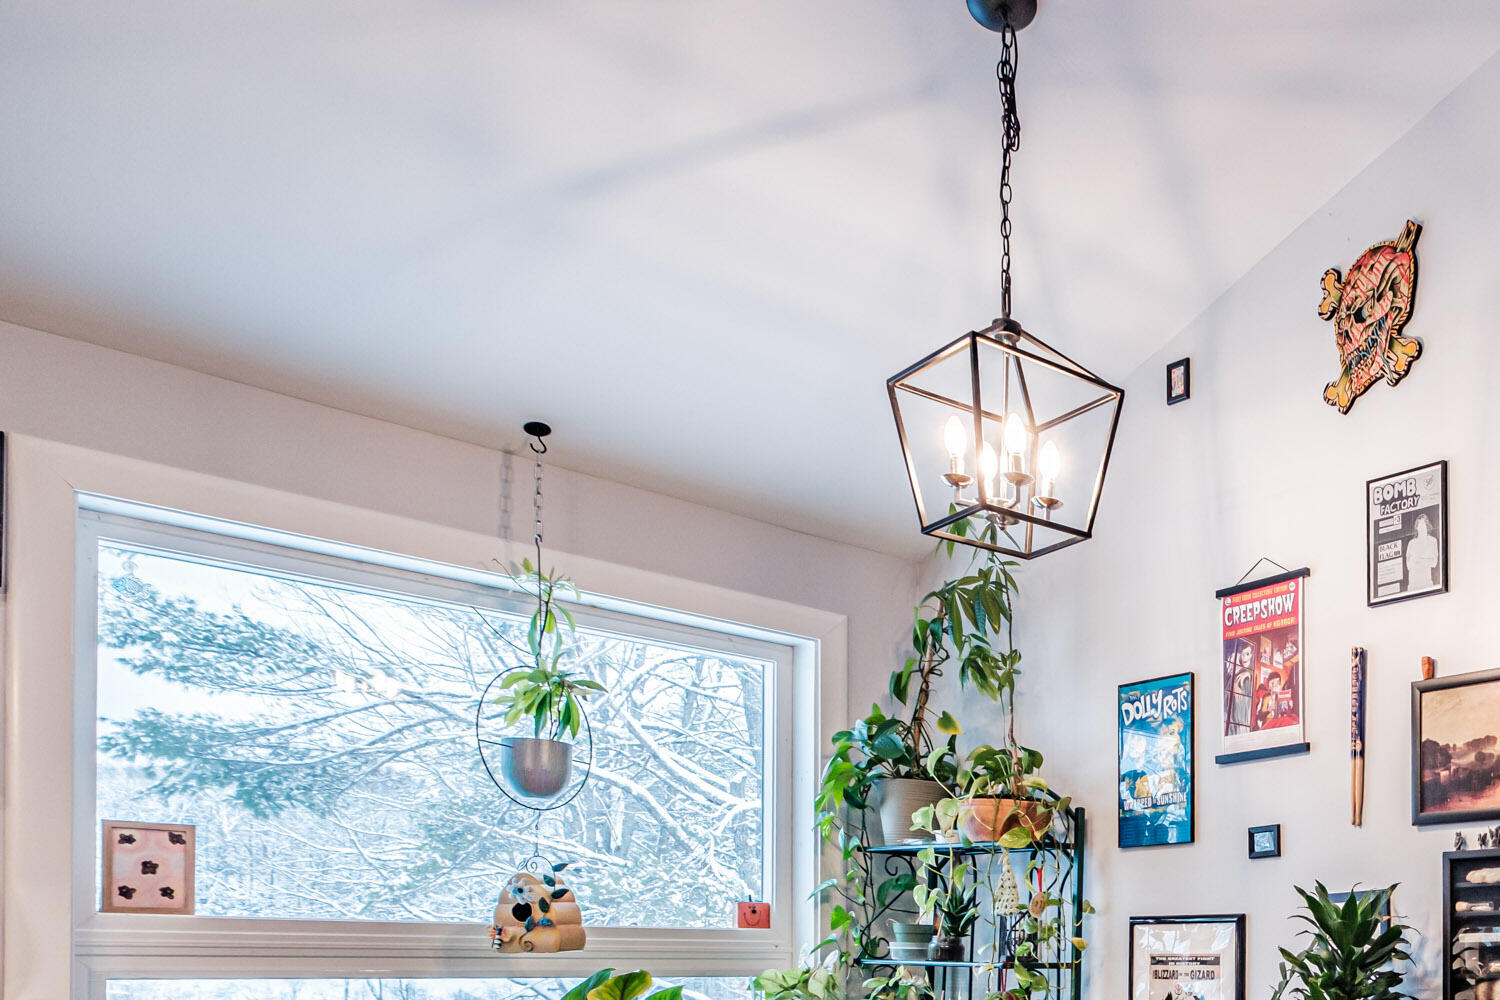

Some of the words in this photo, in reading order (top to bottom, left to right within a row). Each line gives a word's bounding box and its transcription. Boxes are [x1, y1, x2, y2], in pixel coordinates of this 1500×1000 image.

[1373, 478, 1417, 505] BOMB
[1380, 495, 1420, 516] FACTORY
[1224, 593, 1295, 627] CREEPSHOW
[1156, 791, 1187, 805] SUNSHINE
[1190, 969, 1215, 980] GIZARD
